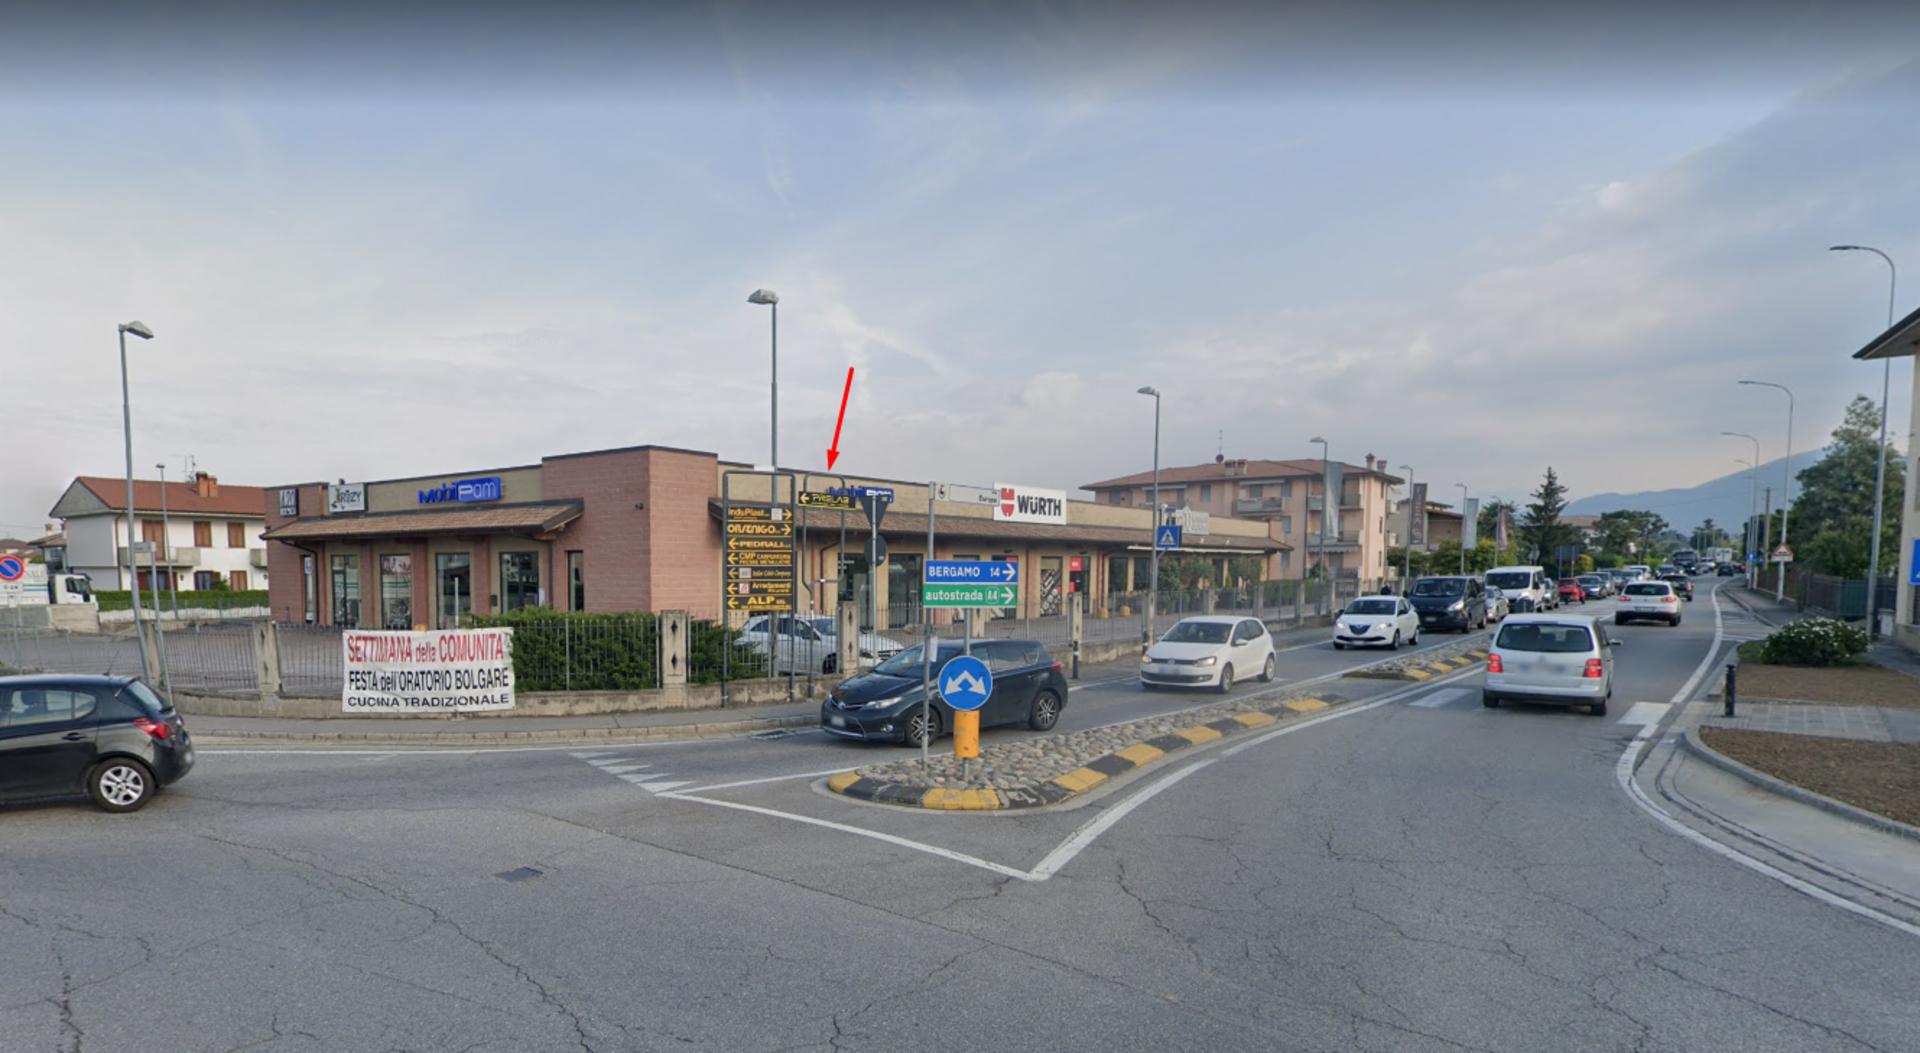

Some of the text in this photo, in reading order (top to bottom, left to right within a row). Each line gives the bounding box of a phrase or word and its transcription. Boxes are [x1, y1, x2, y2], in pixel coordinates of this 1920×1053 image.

[1017, 495, 1062, 516] WÜRTH
[928, 566, 1000, 577] BERGAMO 14
[747, 596, 775, 604] ALP
[926, 590, 983, 601] autostrada
[347, 635, 413, 663] SETTIMANA
[416, 643, 436, 663] della
[349, 667, 510, 692] FESTA dell'ORATORIO BOLGARE
[347, 693, 510, 707] CUCINA TRADIZIONALE
